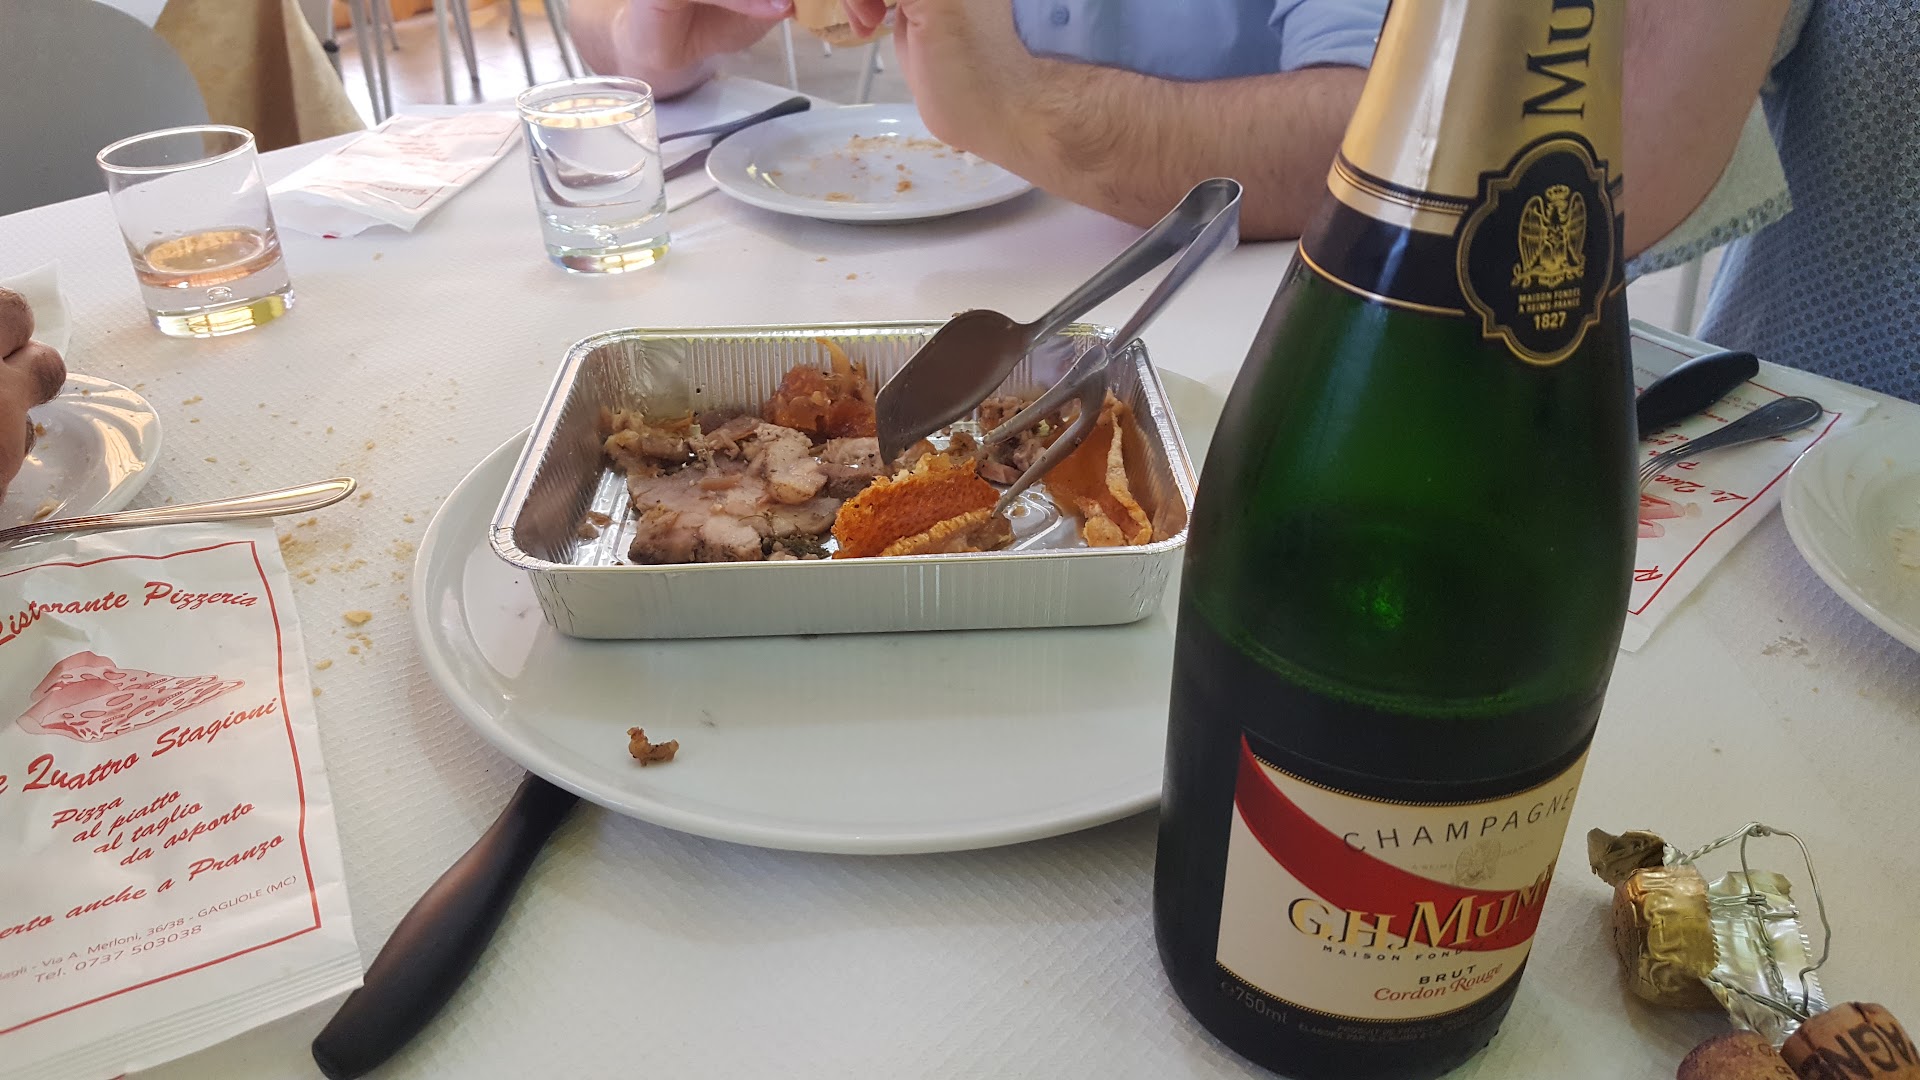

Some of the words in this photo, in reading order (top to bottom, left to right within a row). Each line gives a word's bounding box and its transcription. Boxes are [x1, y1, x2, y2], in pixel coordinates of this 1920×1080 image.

[1533, 311, 1567, 331] 1827
[1655, 473, 1706, 493] Qua
[143, 581, 258, 610] Pizzeria
[22, 752, 140, 793] Quattro
[151, 697, 278, 758] Stagioni
[51, 796, 125, 829] Pizza
[72, 820, 103, 843] al
[107, 790, 181, 837] piatto
[93, 831, 123, 854] al
[131, 802, 203, 843] taglio
[119, 847, 155, 867] da
[163, 802, 256, 849] asporto
[1343, 786, 1575, 853] CHAMPAGNE
[0, 914, 55, 939] erto
[65, 885, 148, 919] anche
[157, 878, 176, 893] a
[188, 834, 285, 882] Pranzo
[41, 956, 63, 967] Via
[147, 917, 185, 937] 36/38
[197, 888, 263, 919] GAGLIOLE
[266, 874, 298, 895] (MC)
[34, 966, 67, 983] Tel.
[75, 950, 125, 972] 0737
[131, 923, 203, 956] 503038
[1322, 944, 1401, 962] MAISON
[1415, 942, 1487, 961] FOND
[1418, 964, 1478, 986] BRUT
[1374, 985, 1447, 1002] Cordon
[1450, 962, 1504, 993] Rouge
